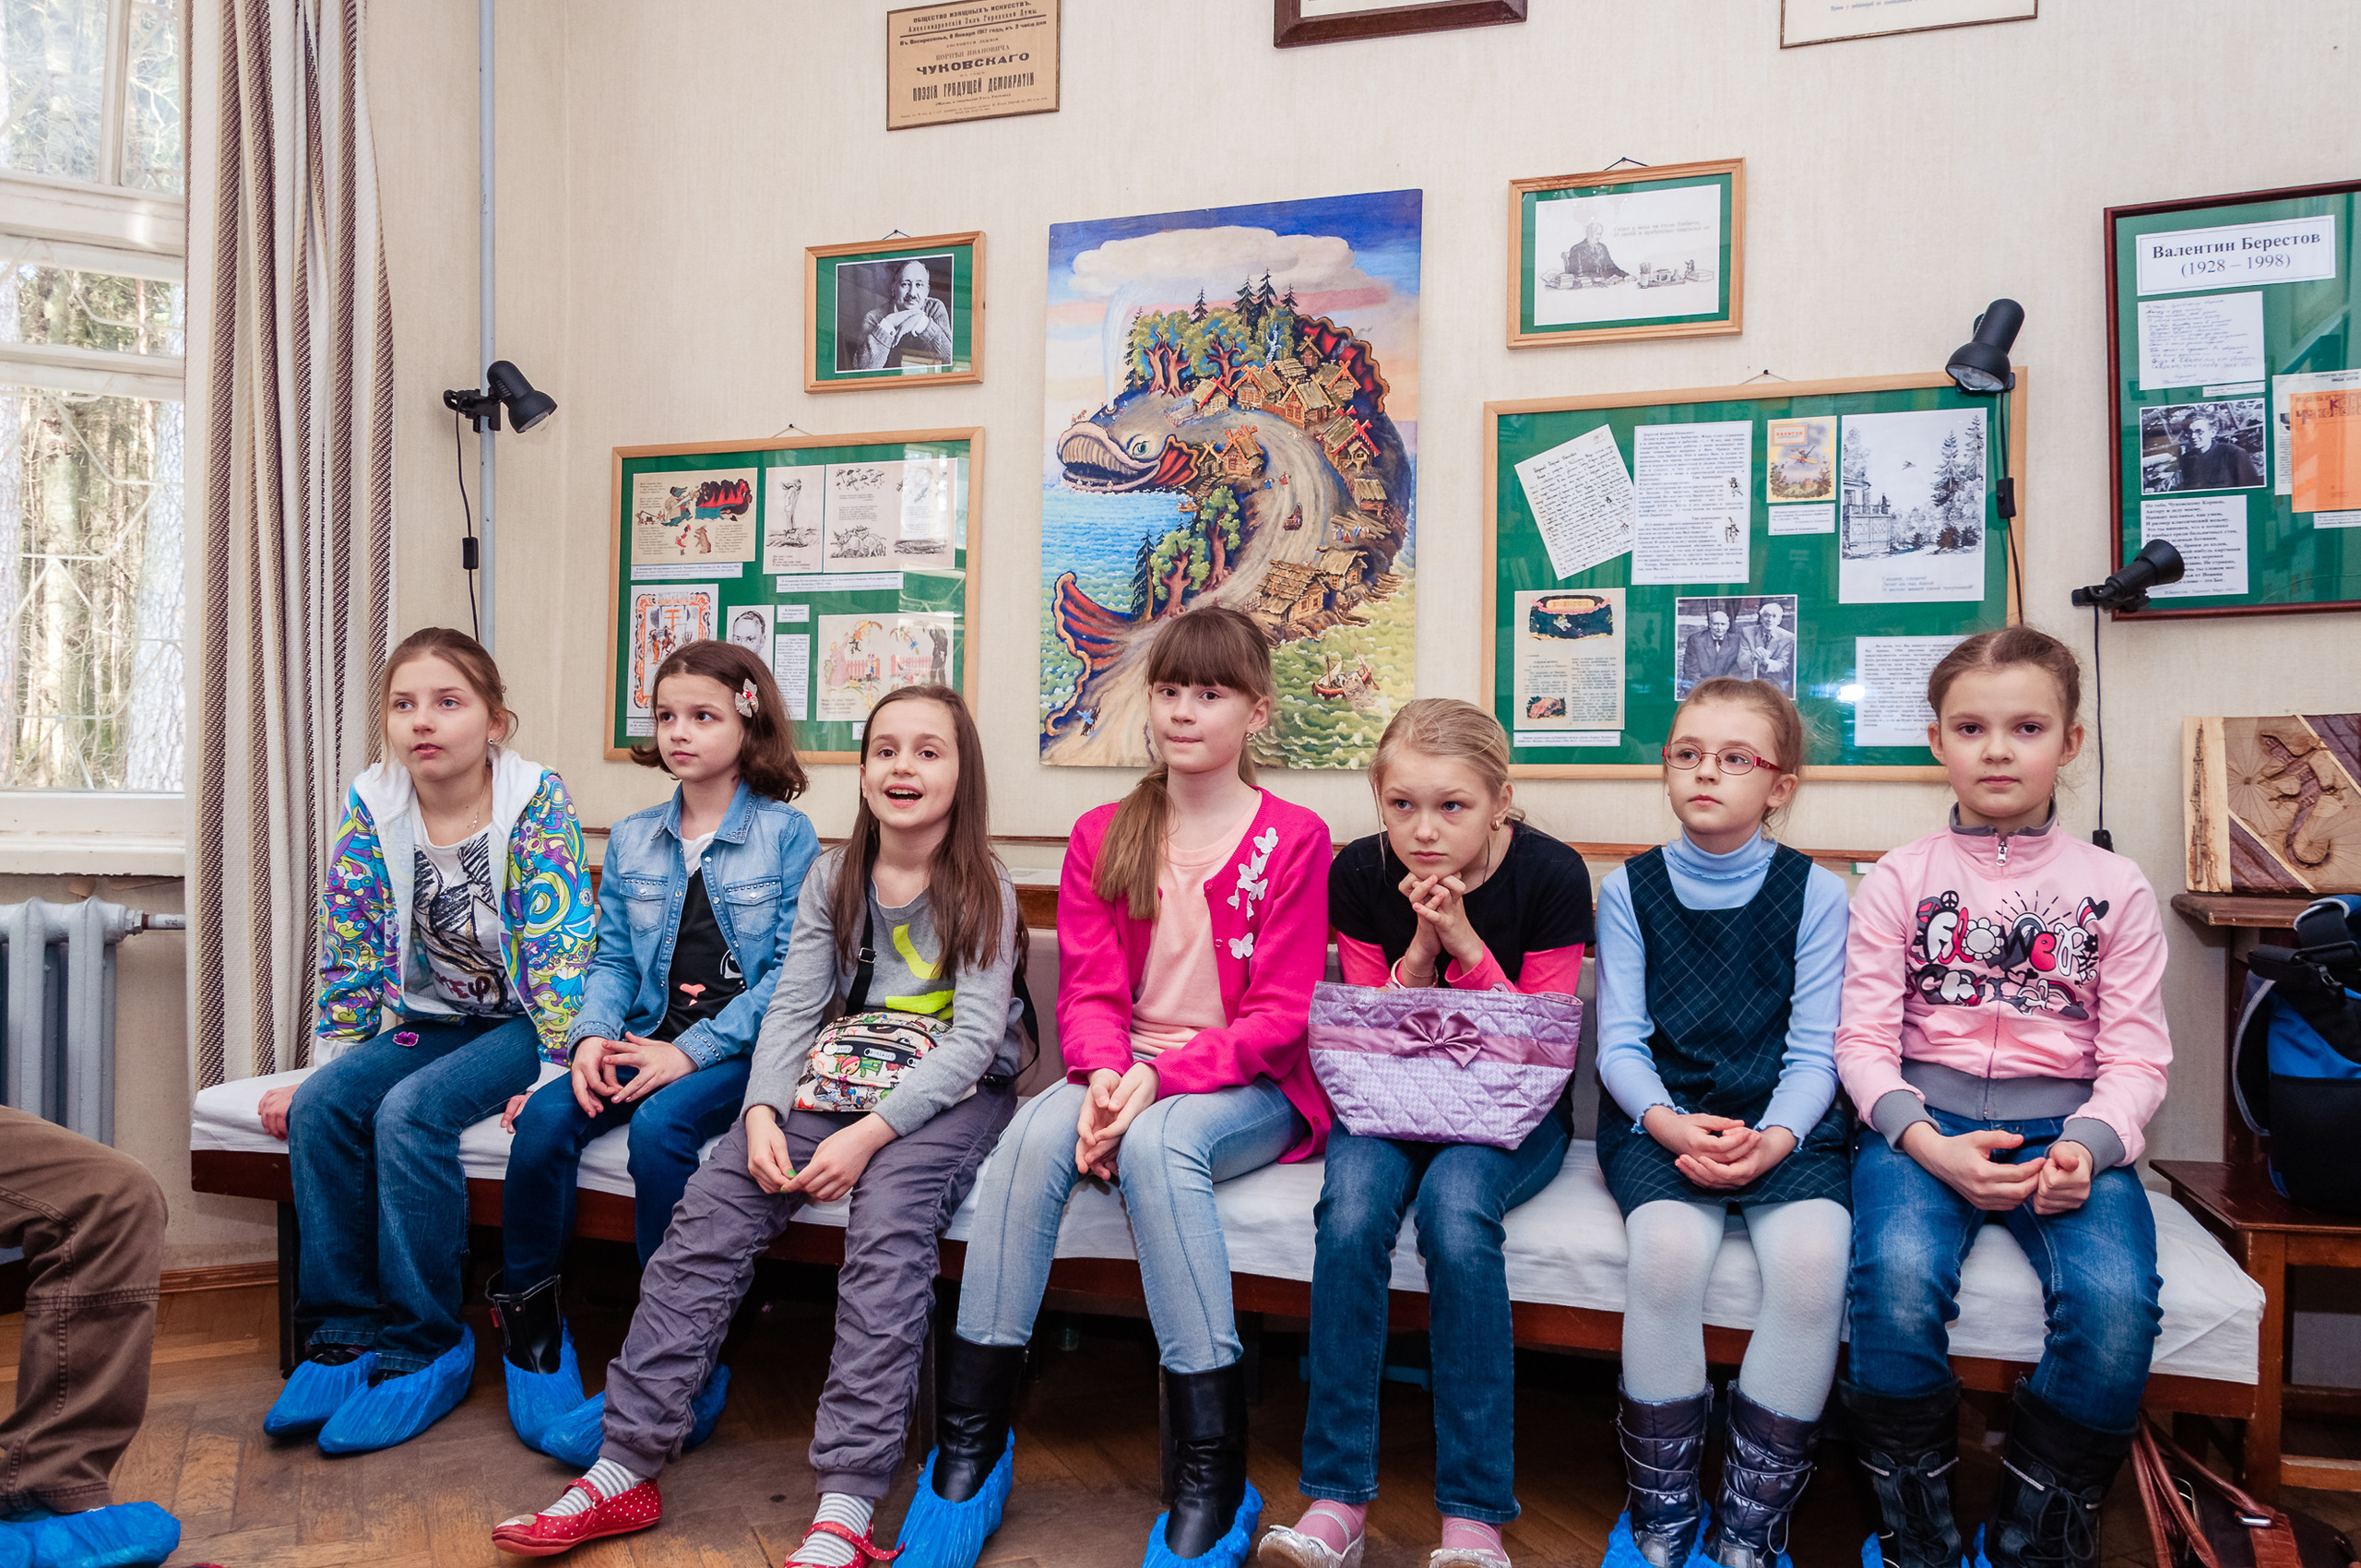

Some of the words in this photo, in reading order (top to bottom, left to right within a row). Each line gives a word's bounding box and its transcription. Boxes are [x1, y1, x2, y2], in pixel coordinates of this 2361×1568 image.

[913, 14, 947, 23] ОБЩЕСТВО
[917, 53, 1030, 76] ЧУКОВСКАГО
[913, 85, 937, 101] ПОЭЗІЯ
[943, 77, 981, 97] ГРЯДУЩЕЙ
[988, 72, 1034, 93] ДЕМОКРАТІИ
[2153, 242, 2235, 259] Валентин
[2241, 232, 2320, 252] Берестов
[2181, 259, 2226, 278] (1928
[2248, 254, 2291, 270] 1998)
